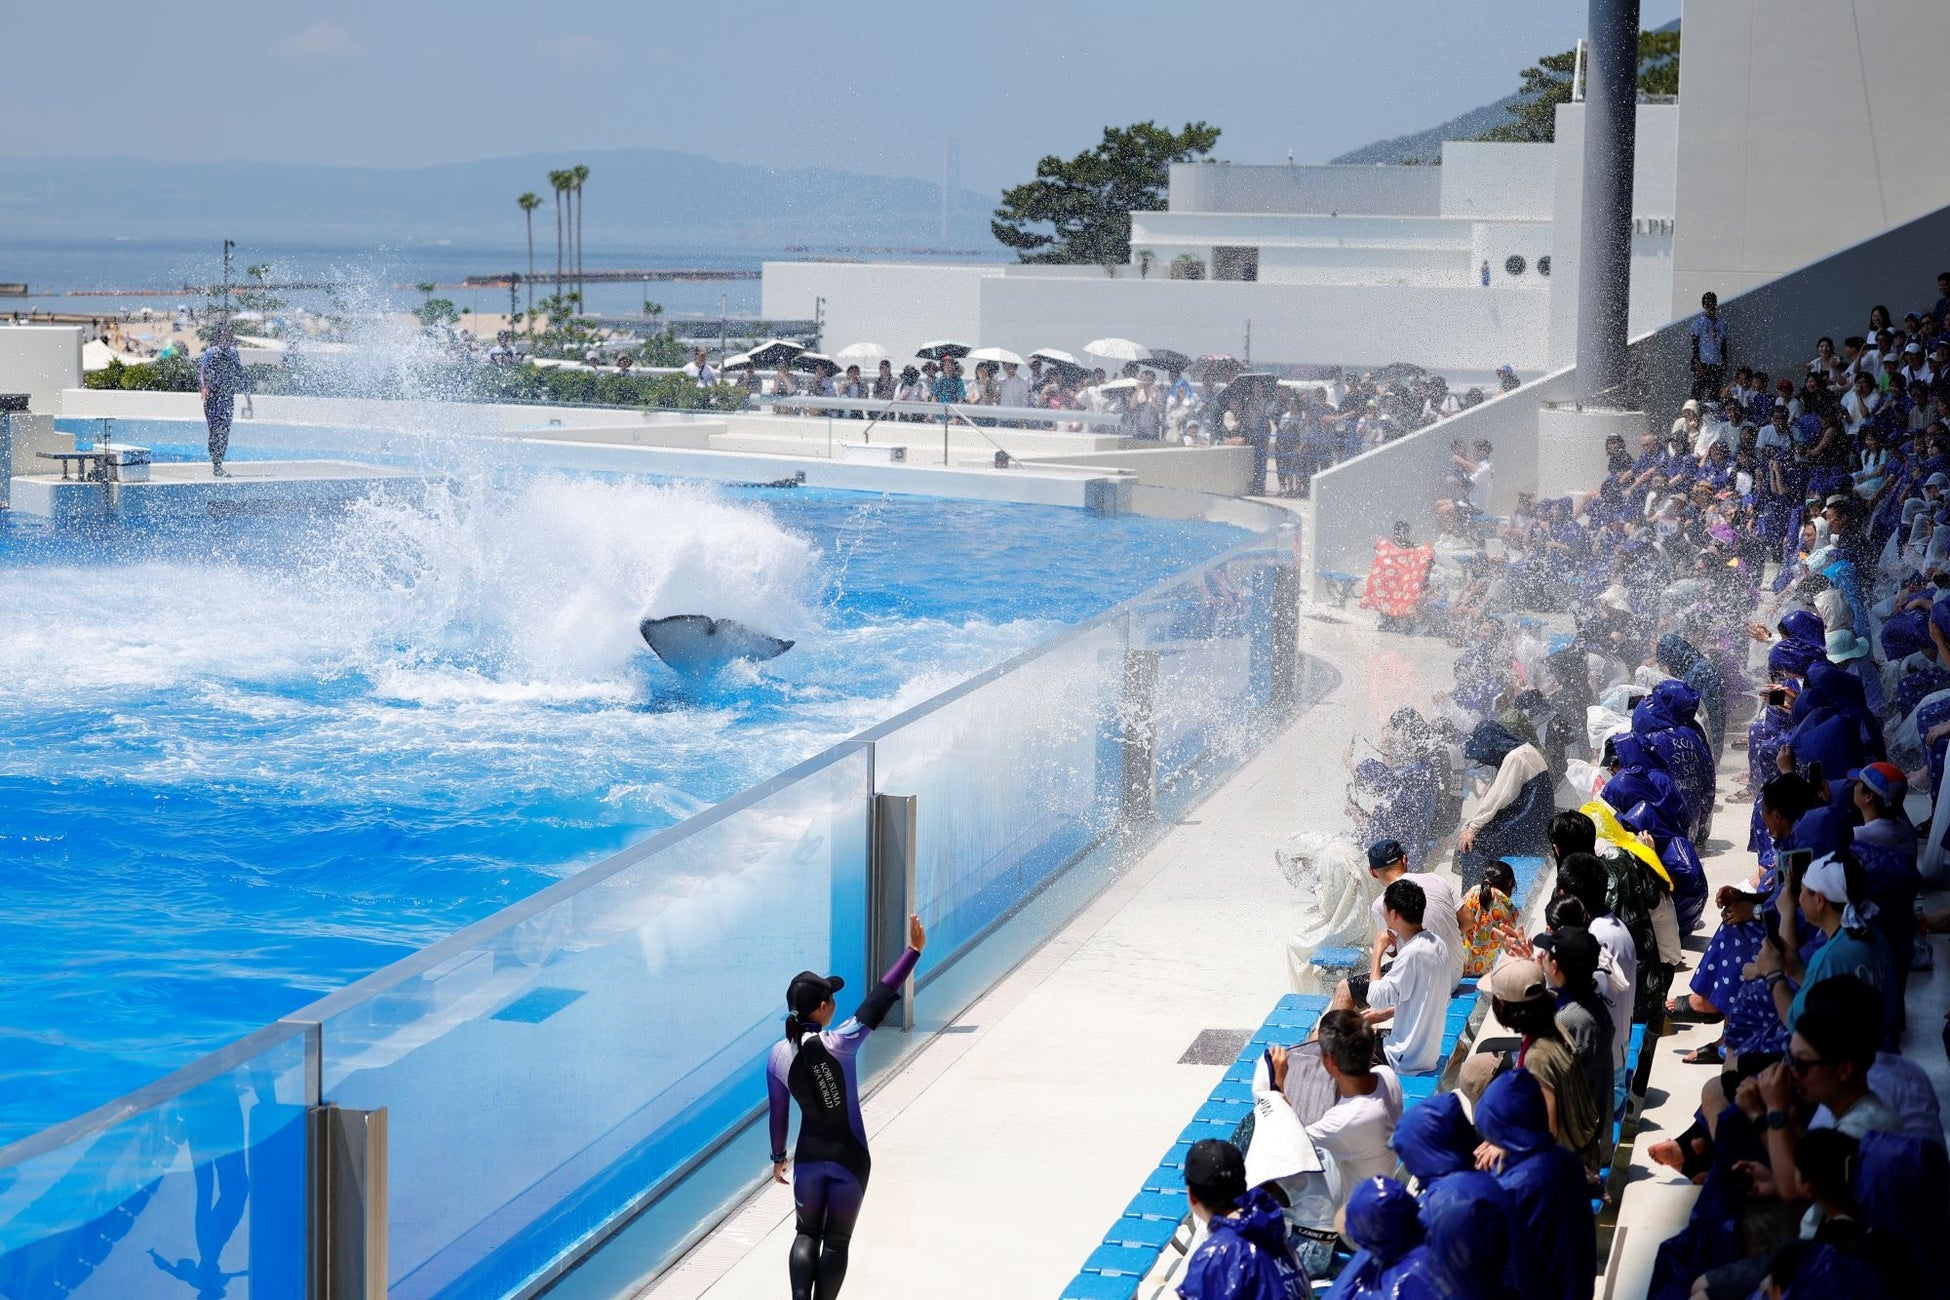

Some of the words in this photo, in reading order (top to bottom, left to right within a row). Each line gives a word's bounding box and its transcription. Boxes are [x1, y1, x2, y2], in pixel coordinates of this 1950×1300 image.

[1636, 216, 1674, 235] LPH
[811, 1064, 823, 1081] SEA
[818, 1078, 834, 1109] WORLD
[820, 1062, 835, 1083] KOBE
[829, 1082, 842, 1107] SUMA
